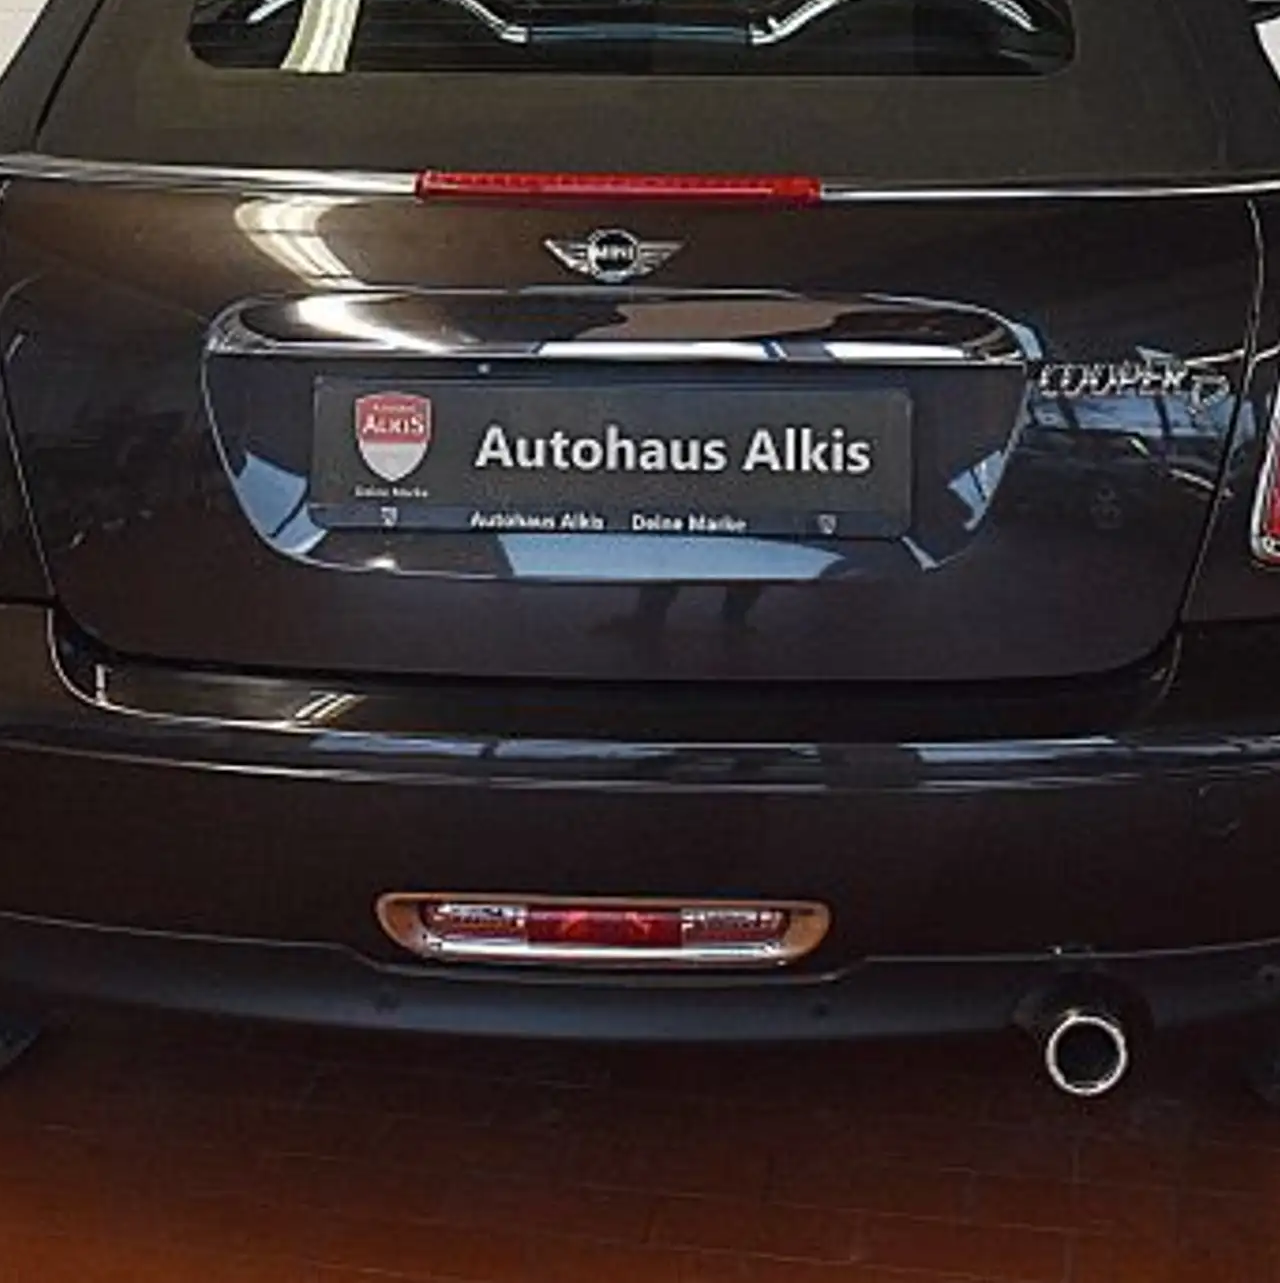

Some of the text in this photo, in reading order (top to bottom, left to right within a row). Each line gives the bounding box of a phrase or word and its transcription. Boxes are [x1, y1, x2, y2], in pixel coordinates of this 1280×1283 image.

[475, 425, 872, 474] Autohaus Alkis
[470, 511, 604, 530] Autohaus Alkis
[632, 514, 748, 533] Deine Marke
